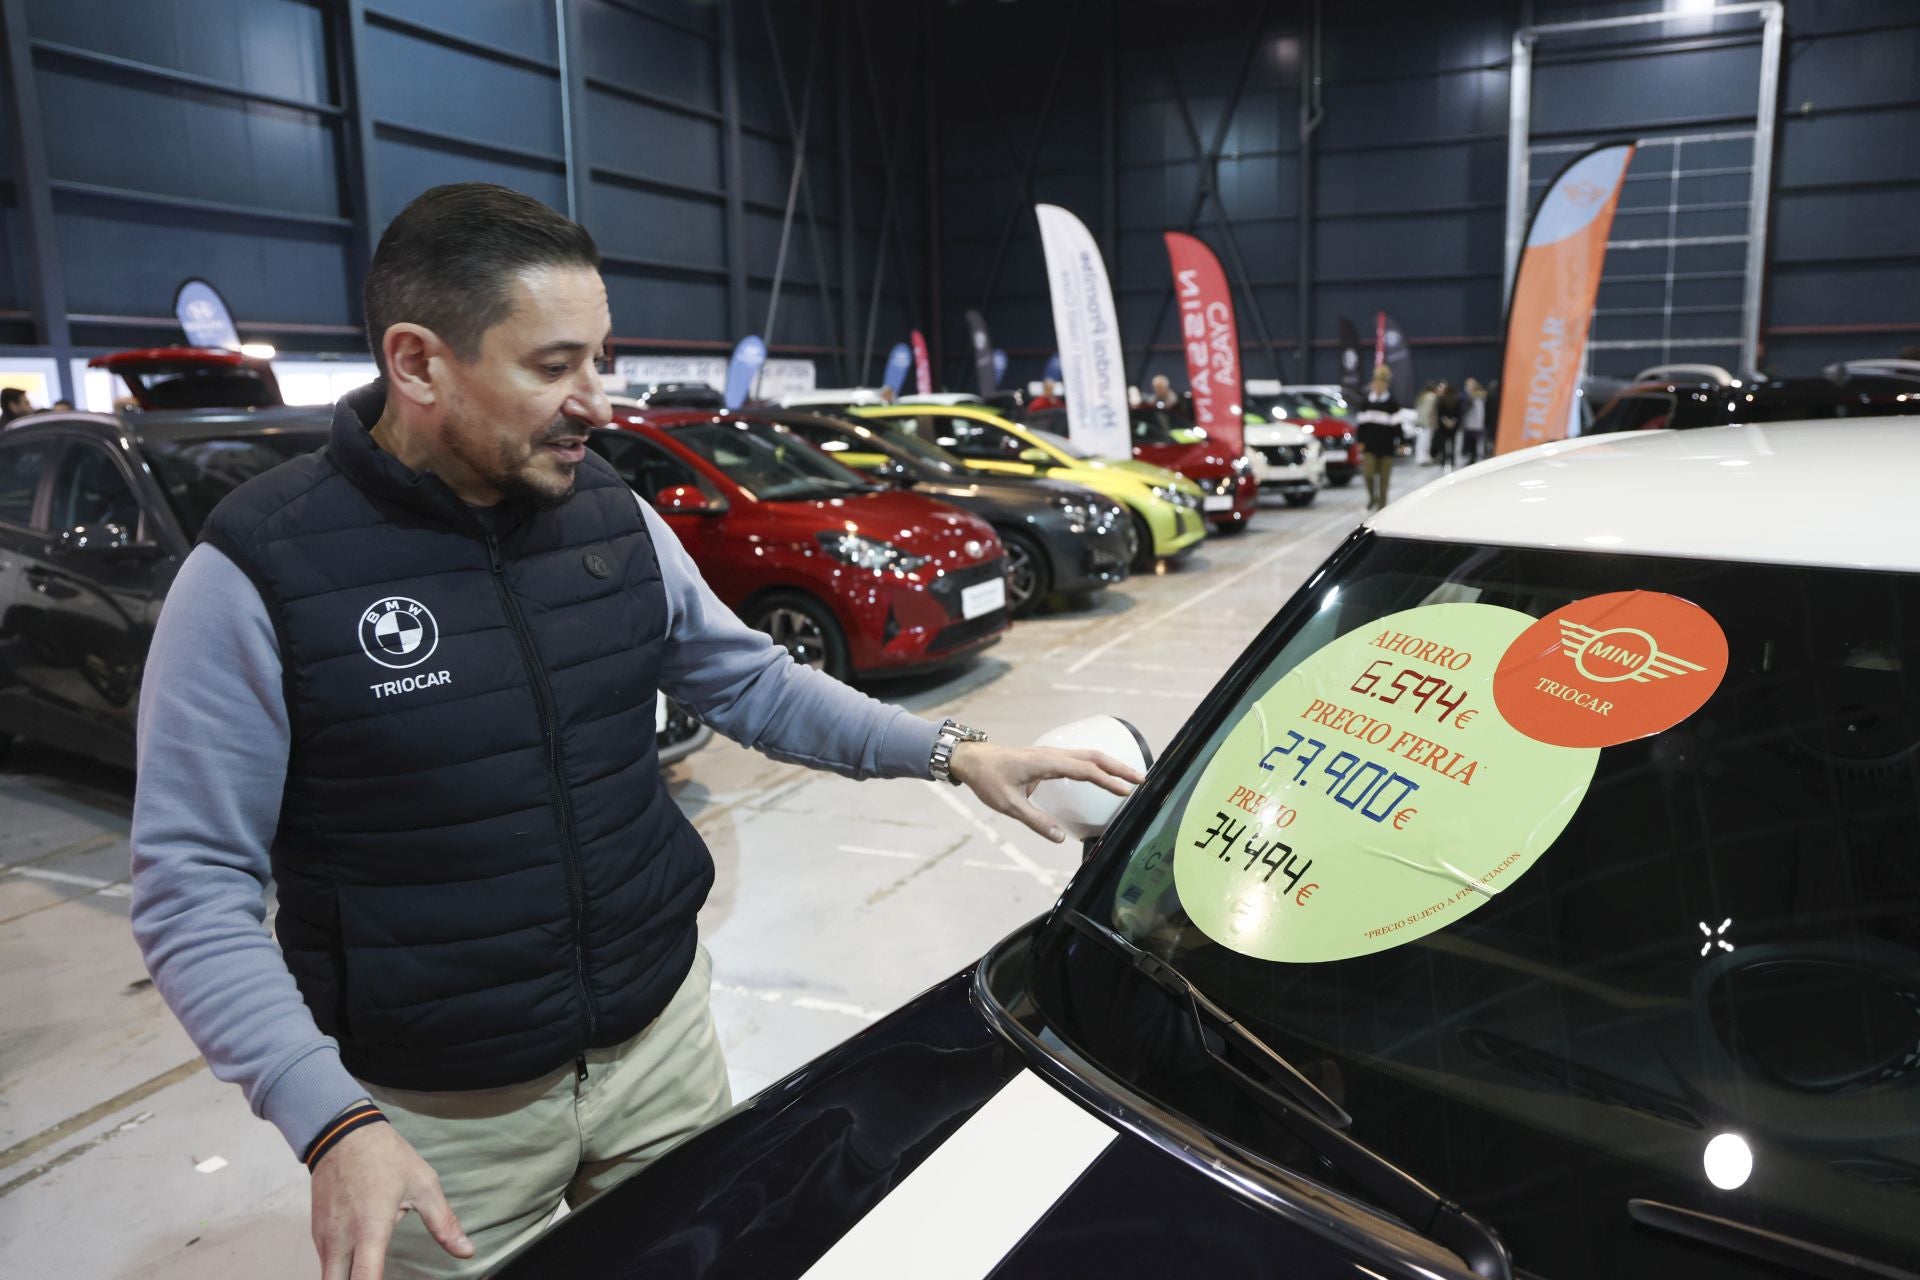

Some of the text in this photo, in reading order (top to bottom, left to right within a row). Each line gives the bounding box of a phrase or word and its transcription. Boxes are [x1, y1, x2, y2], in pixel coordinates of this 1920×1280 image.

[1521, 316, 1566, 442] TRIOCAR
[365, 600, 423, 625] BMW
[1367, 630, 1473, 671] AHORRO
[1588, 641, 1645, 669] MINI
[369, 670, 452, 699] TRIOCAR
[1534, 677, 1614, 716] TRIOCAR
[1300, 699, 1392, 745] PRECIO
[1226, 785, 1297, 829] PREO
[1406, 901, 1445, 925] SUJETO
[1446, 897, 1456, 907] A
[1455, 850, 1521, 901] FINCIACION
